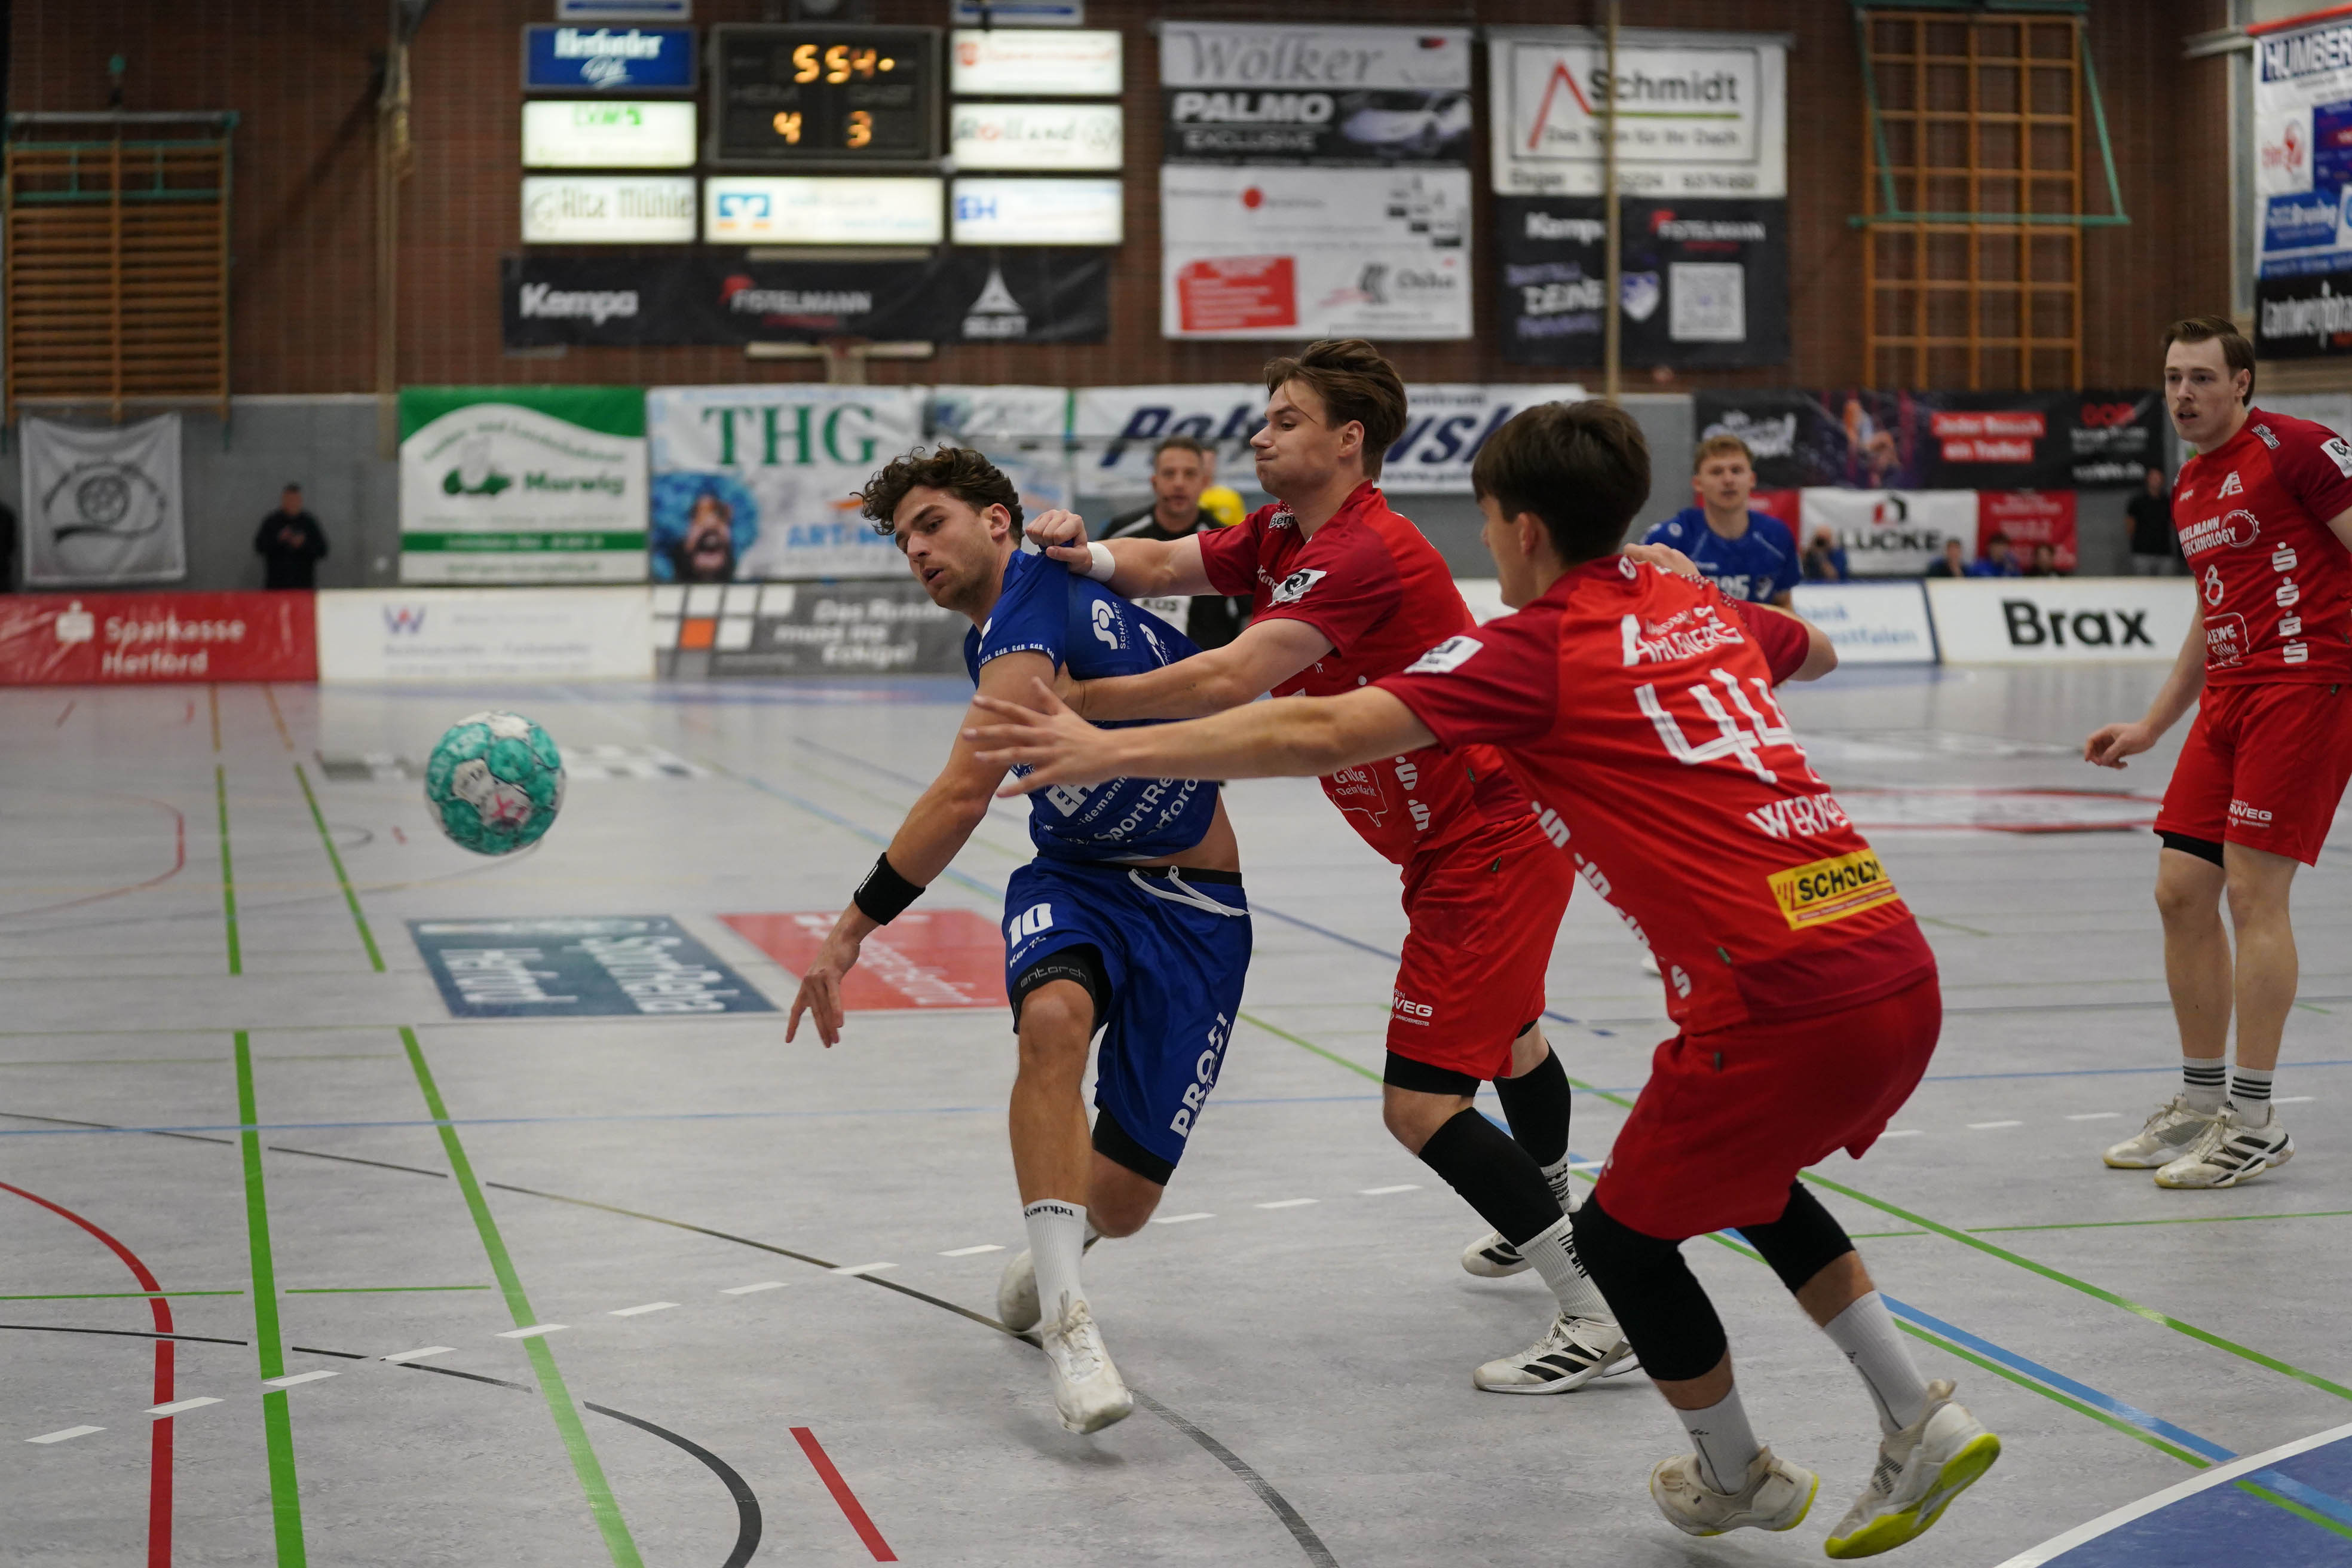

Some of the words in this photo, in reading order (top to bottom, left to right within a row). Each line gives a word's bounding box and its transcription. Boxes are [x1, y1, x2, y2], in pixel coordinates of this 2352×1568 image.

[1588, 68, 1739, 102] Schmidt
[1172, 93, 1334, 123] PALMO
[519, 281, 639, 325] Kempa
[702, 404, 877, 465] THG
[2204, 564, 2224, 607] 8
[104, 614, 246, 649] Sparkasse
[1111, 601, 1126, 650] SCHÄFER
[2003, 599, 2155, 647] Brax
[1333, 767, 1369, 785] Gilke
[1009, 903, 1054, 950] 10
[1024, 1204, 1074, 1219] Kempa
